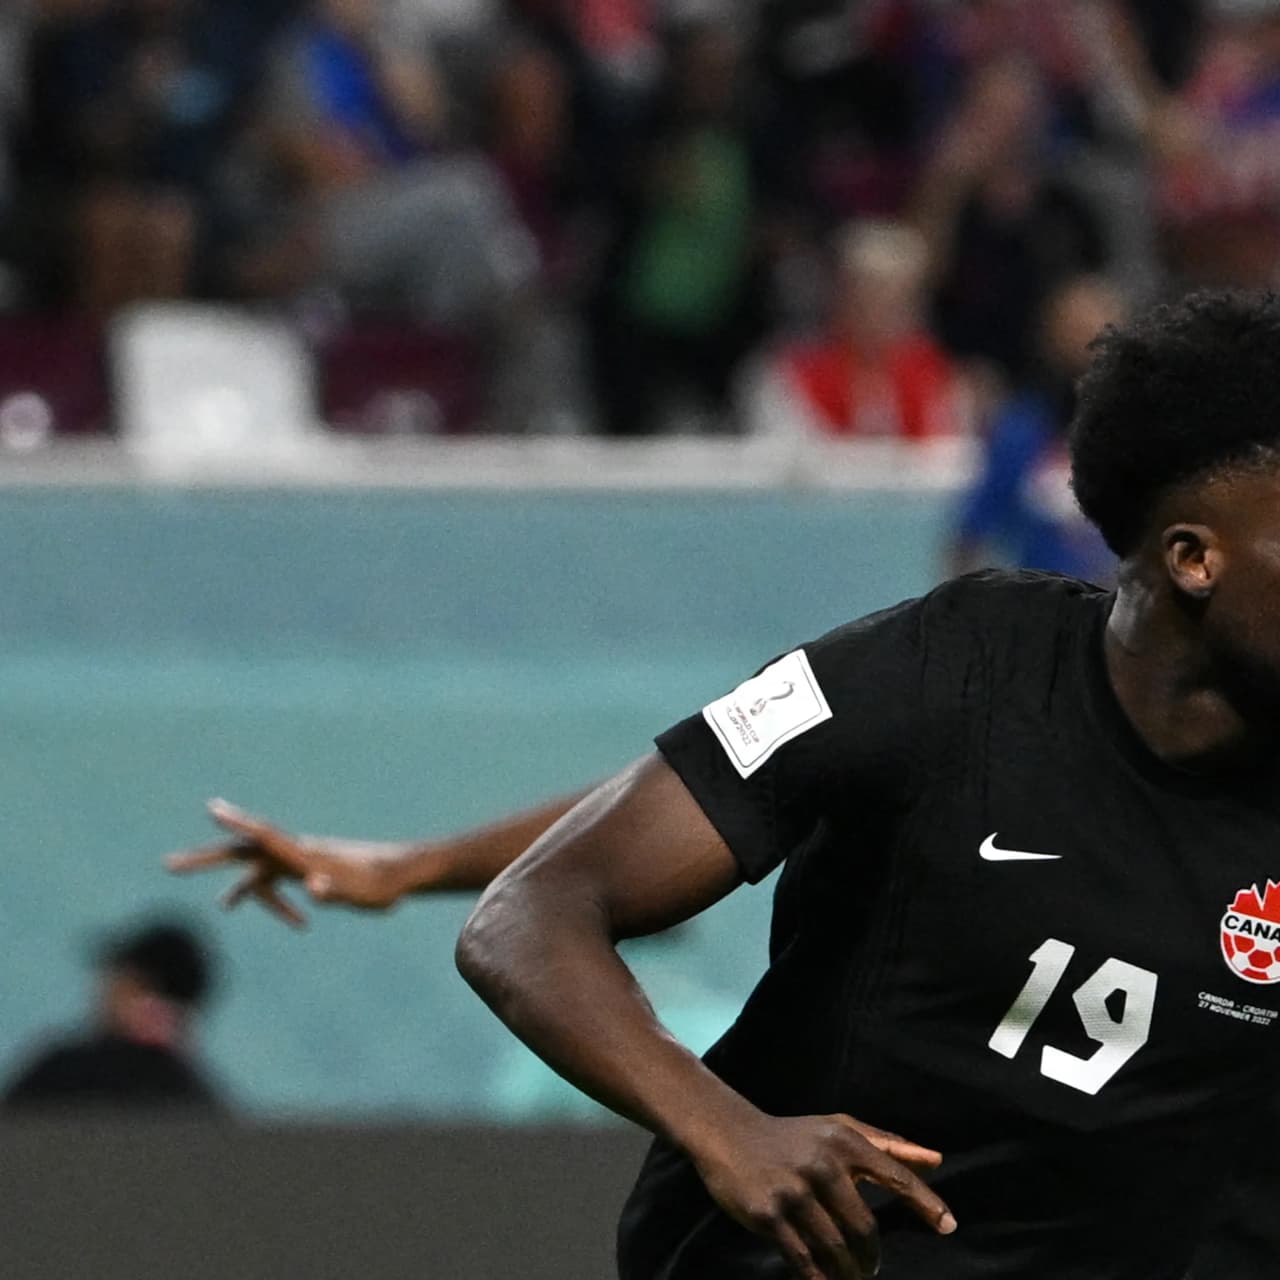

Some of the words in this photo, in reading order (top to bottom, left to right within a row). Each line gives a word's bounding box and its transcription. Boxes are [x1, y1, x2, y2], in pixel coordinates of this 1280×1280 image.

[988, 938, 1158, 1095] 19
[1198, 992, 1235, 1008] CANADA
[1242, 1005, 1279, 1019] CROATIA
[1198, 1001, 1209, 1009] 27
[1209, 1004, 1251, 1022] NOVEMBER
[1251, 1015, 1271, 1026] 2022
